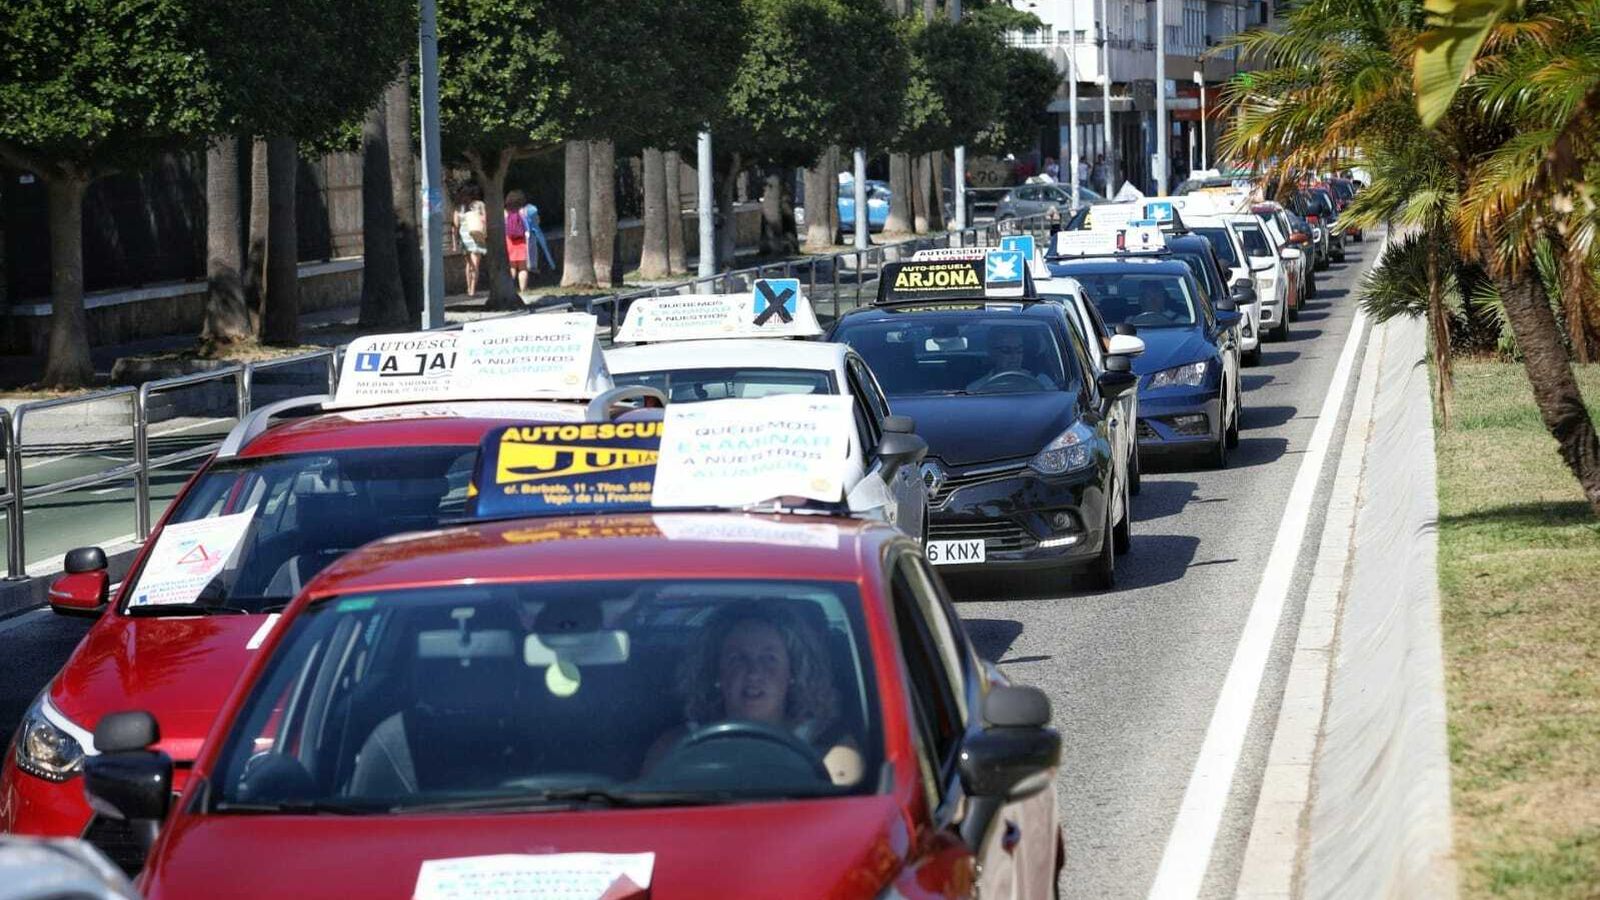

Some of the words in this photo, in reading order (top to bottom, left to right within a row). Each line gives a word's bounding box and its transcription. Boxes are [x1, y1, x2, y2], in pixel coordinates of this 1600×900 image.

[902, 264, 972, 272] AUTO-ESCUELA
[895, 270, 980, 287] ARJONA
[482, 333, 571, 346] QUEREMOS
[468, 344, 581, 357] EXAMINAR
[488, 355, 574, 366] NUESTROS
[695, 420, 817, 437] QUEREMOS
[677, 433, 832, 453] EXAMINAR
[683, 456, 695, 466] A
[705, 447, 822, 465] NUESTROS
[575, 493, 592, 504] de
[593, 493, 605, 504] la
[927, 544, 938, 561] 6
[946, 542, 980, 561] KNX
